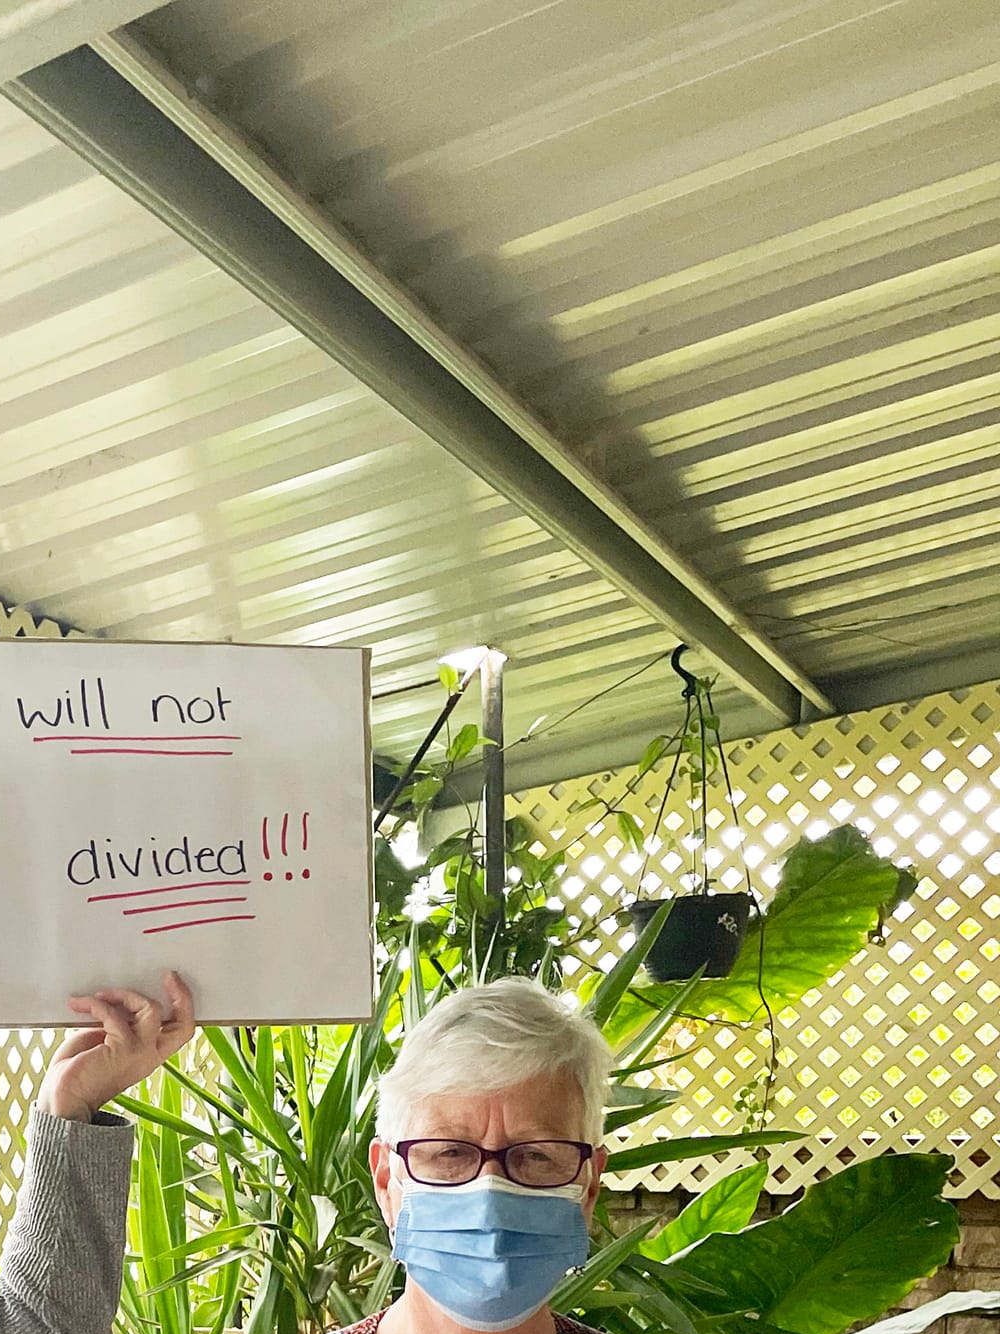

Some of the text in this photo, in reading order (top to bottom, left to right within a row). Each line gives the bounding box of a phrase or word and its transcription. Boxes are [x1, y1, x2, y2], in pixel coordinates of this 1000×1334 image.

[16, 677, 110, 730] will
[151, 686, 232, 724] not
[67, 811, 310, 886] divided!!!
